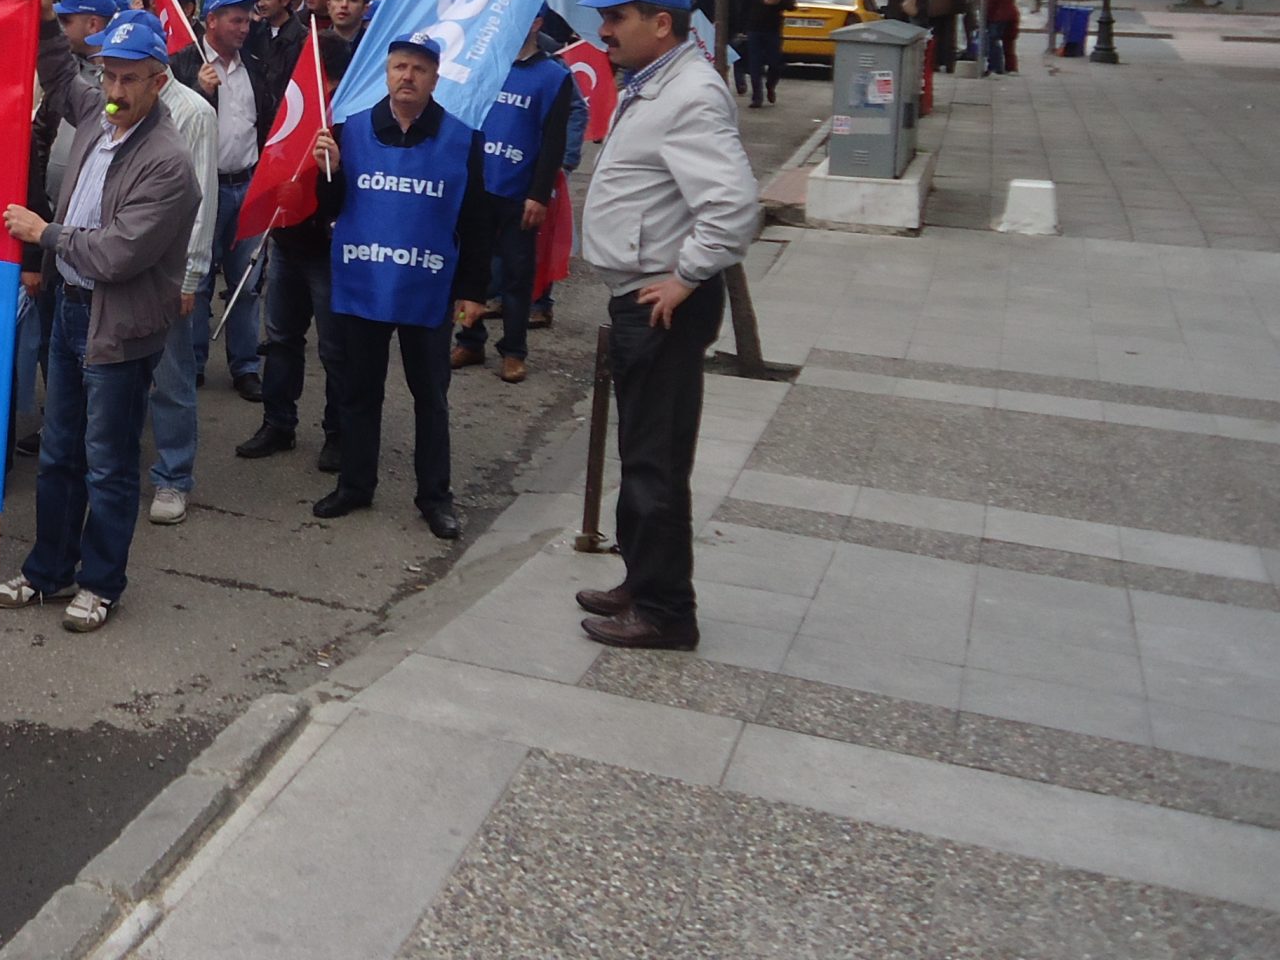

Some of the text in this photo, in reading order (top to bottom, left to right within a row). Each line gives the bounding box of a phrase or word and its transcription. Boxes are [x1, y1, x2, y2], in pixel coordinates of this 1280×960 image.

[496, 91, 531, 109] EVLİ
[483, 142, 524, 164] ol-iş
[357, 171, 444, 198] GÖREVLİ
[343, 243, 444, 274] petrol-iş
